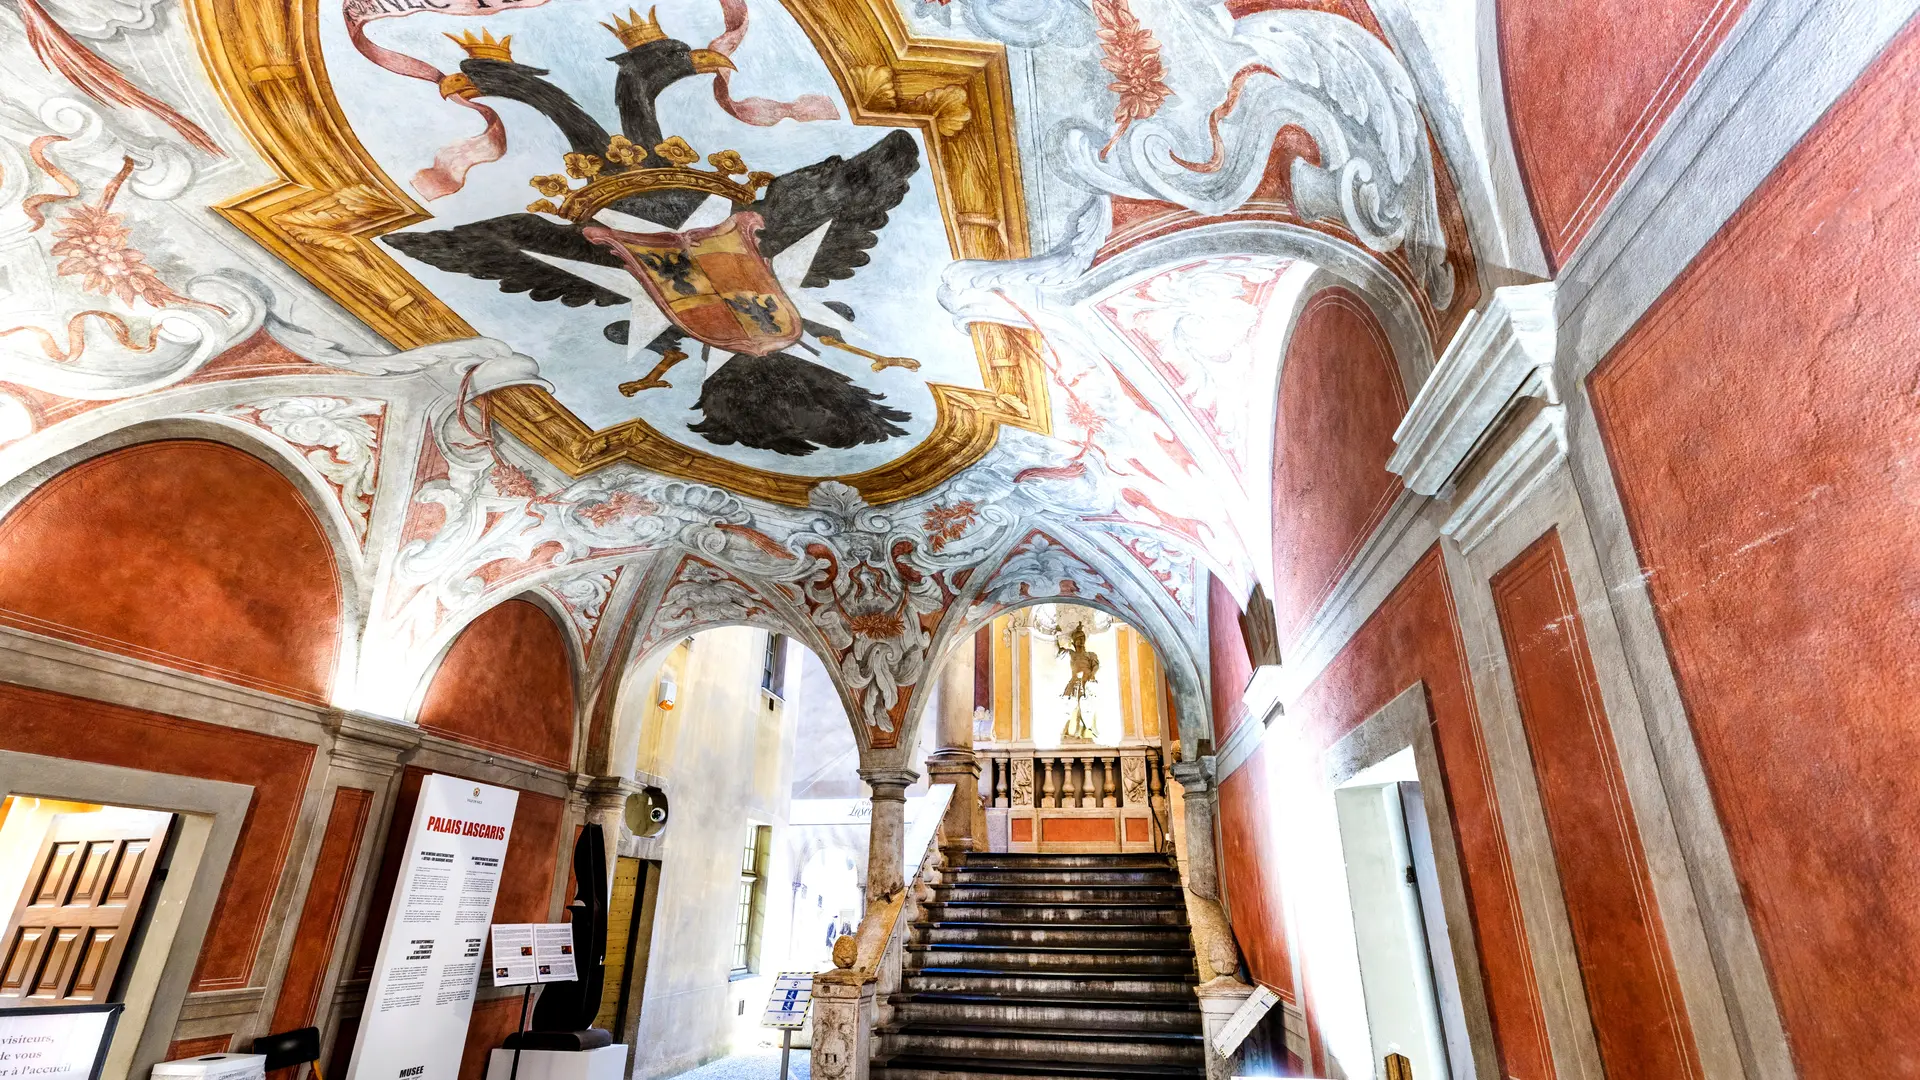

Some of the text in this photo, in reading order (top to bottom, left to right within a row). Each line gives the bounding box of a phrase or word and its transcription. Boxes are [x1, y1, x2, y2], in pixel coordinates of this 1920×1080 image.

[427, 816, 506, 841] PALAIS LASCARIS
[2, 1035, 55, 1044] visiteurs,
[15, 1051, 42, 1060] vous
[11, 1066, 18, 1076] à
[399, 1065, 424, 1078] MUSEE
